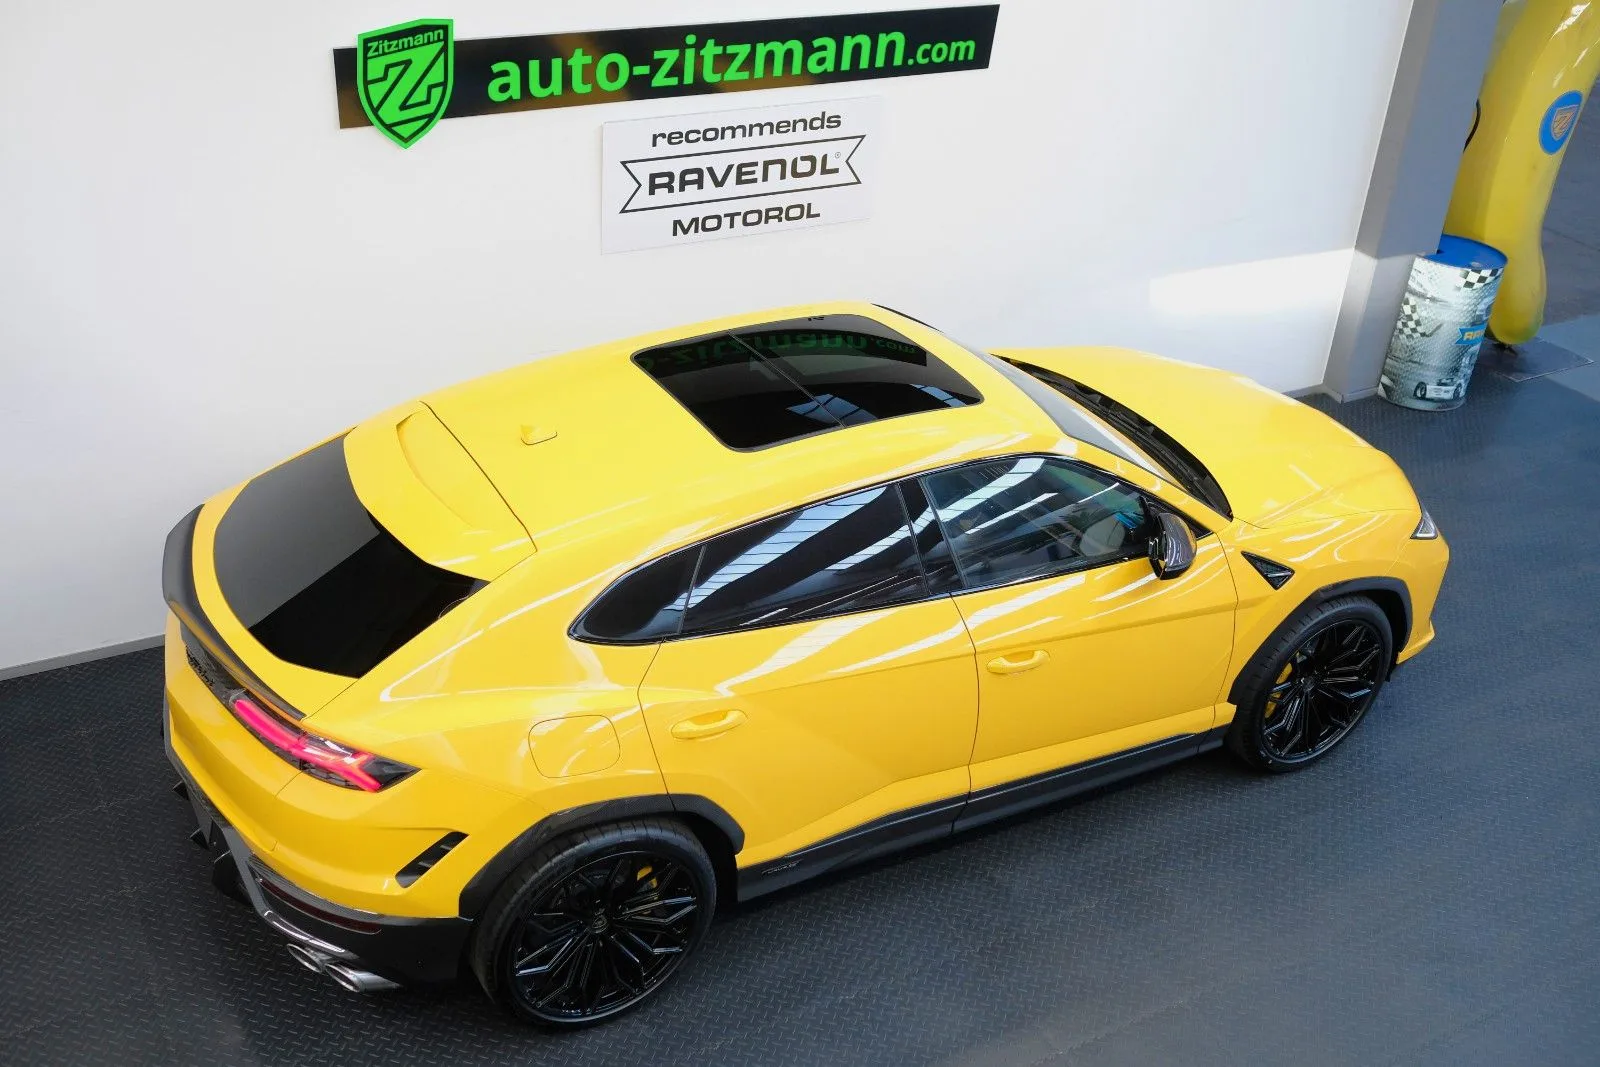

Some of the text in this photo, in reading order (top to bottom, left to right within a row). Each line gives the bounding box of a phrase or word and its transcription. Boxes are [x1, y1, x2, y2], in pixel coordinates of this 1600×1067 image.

[367, 29, 444, 58] Zitzmann
[487, 31, 976, 102] auto-zitzmann.com
[651, 111, 842, 148] recommends
[648, 153, 840, 196] RAVENOL
[672, 202, 821, 237] MOTOROL
